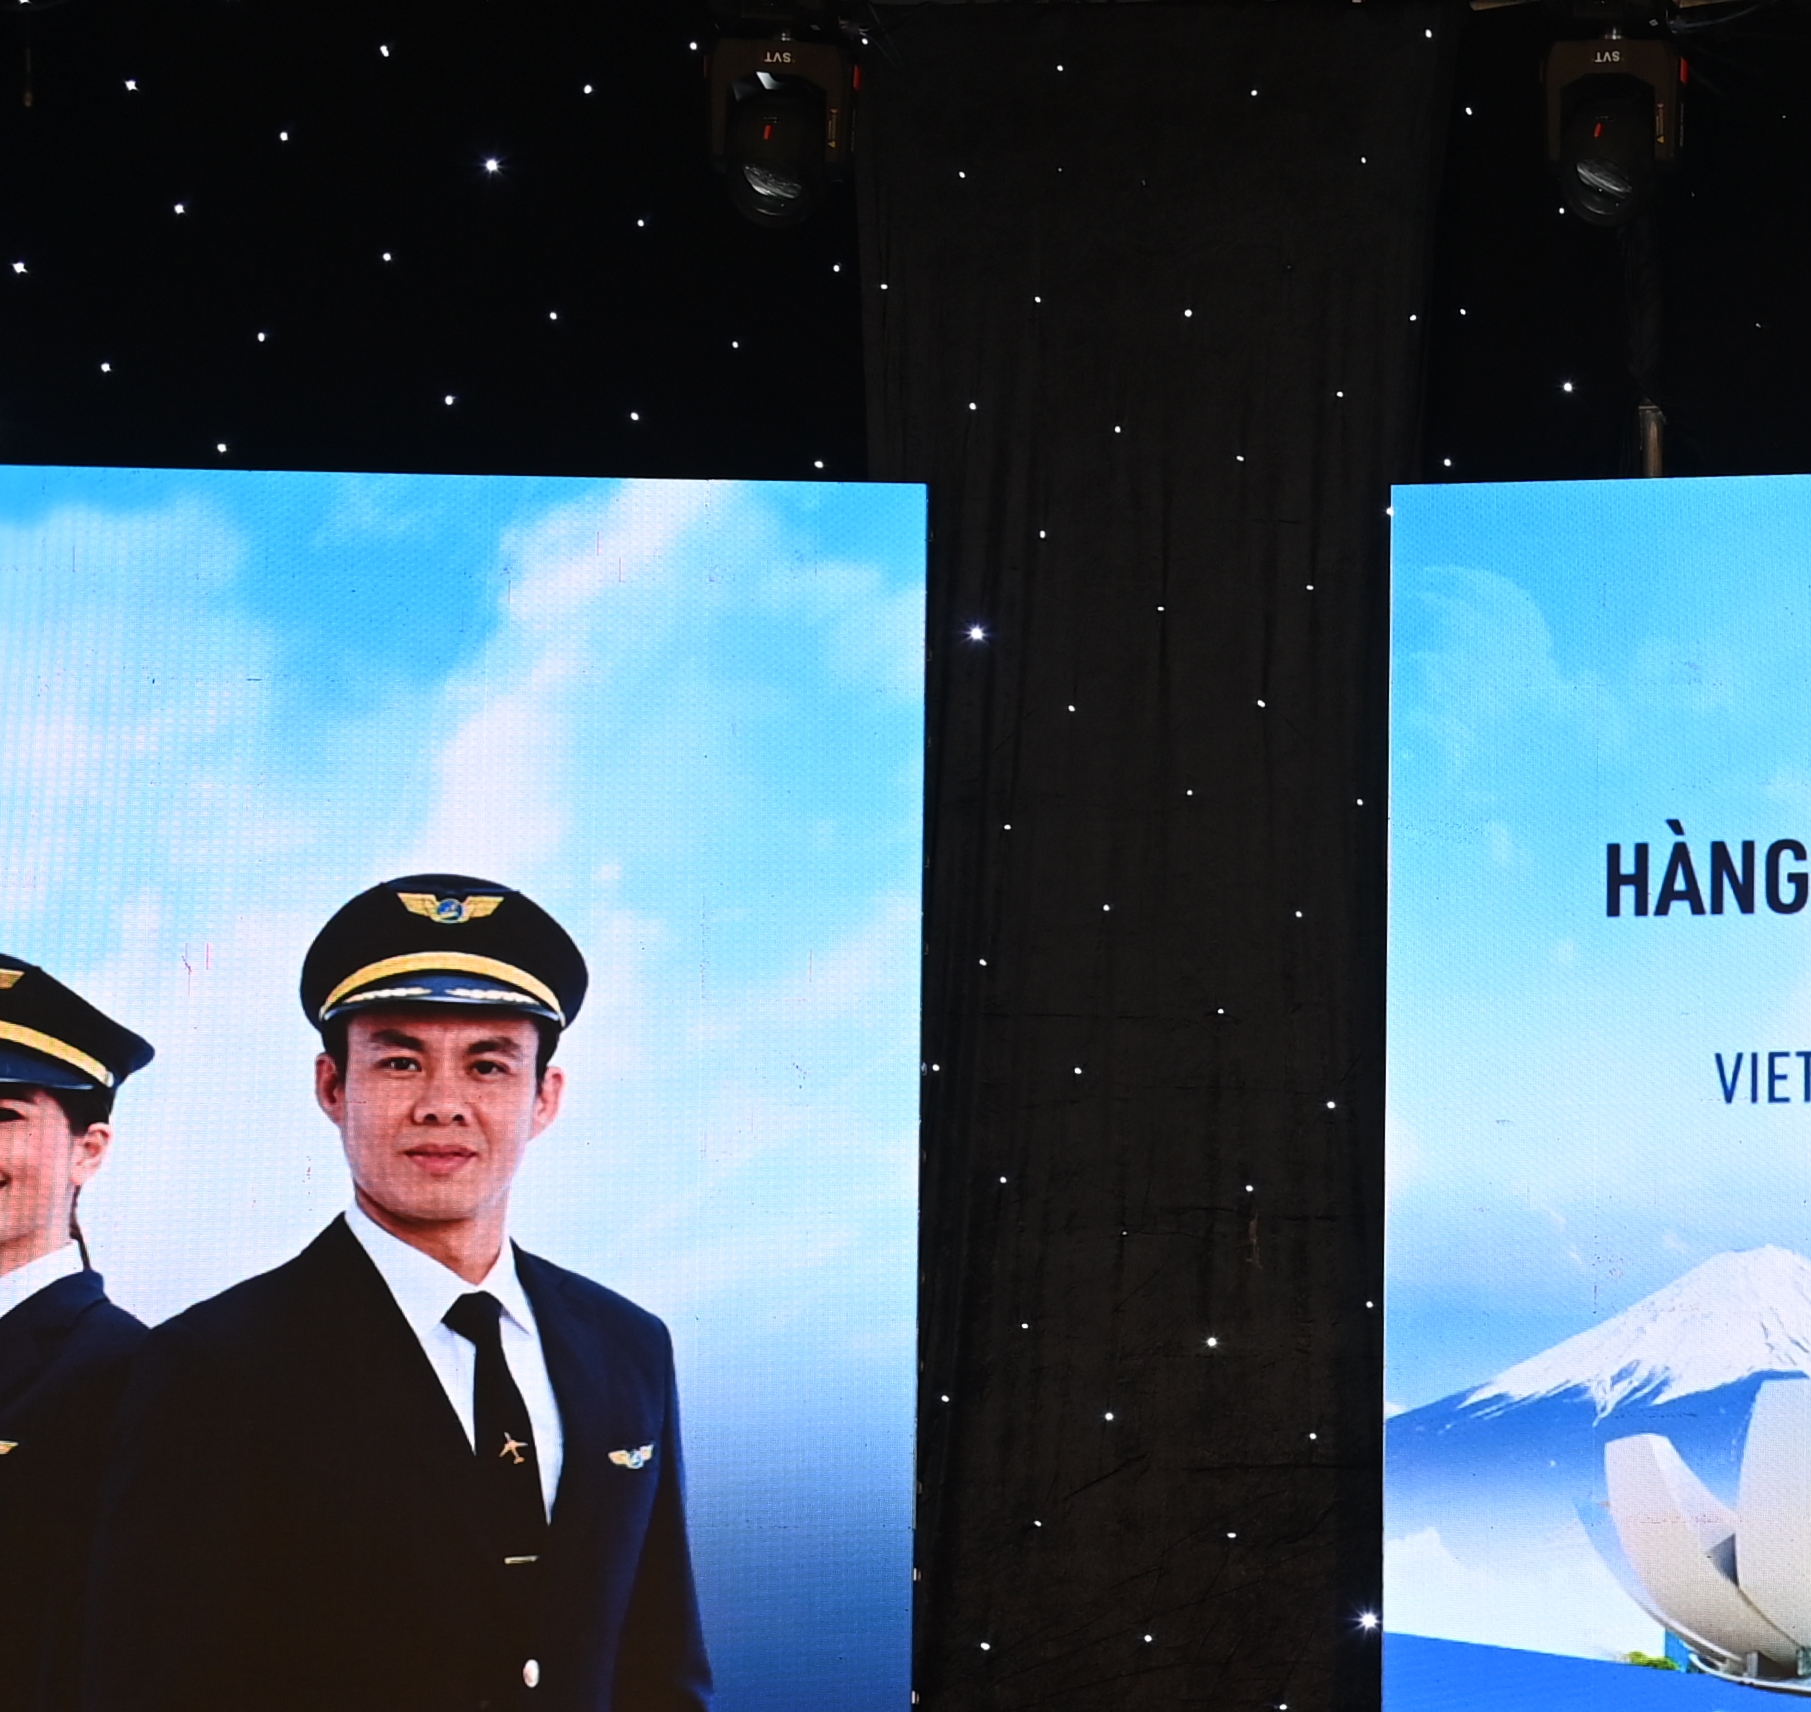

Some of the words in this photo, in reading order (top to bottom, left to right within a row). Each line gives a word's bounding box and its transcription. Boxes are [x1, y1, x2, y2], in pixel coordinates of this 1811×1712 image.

[764, 51, 792, 64] SVT
[1594, 50, 1621, 63] SVT
[1605, 818, 1809, 918] HÀNG
